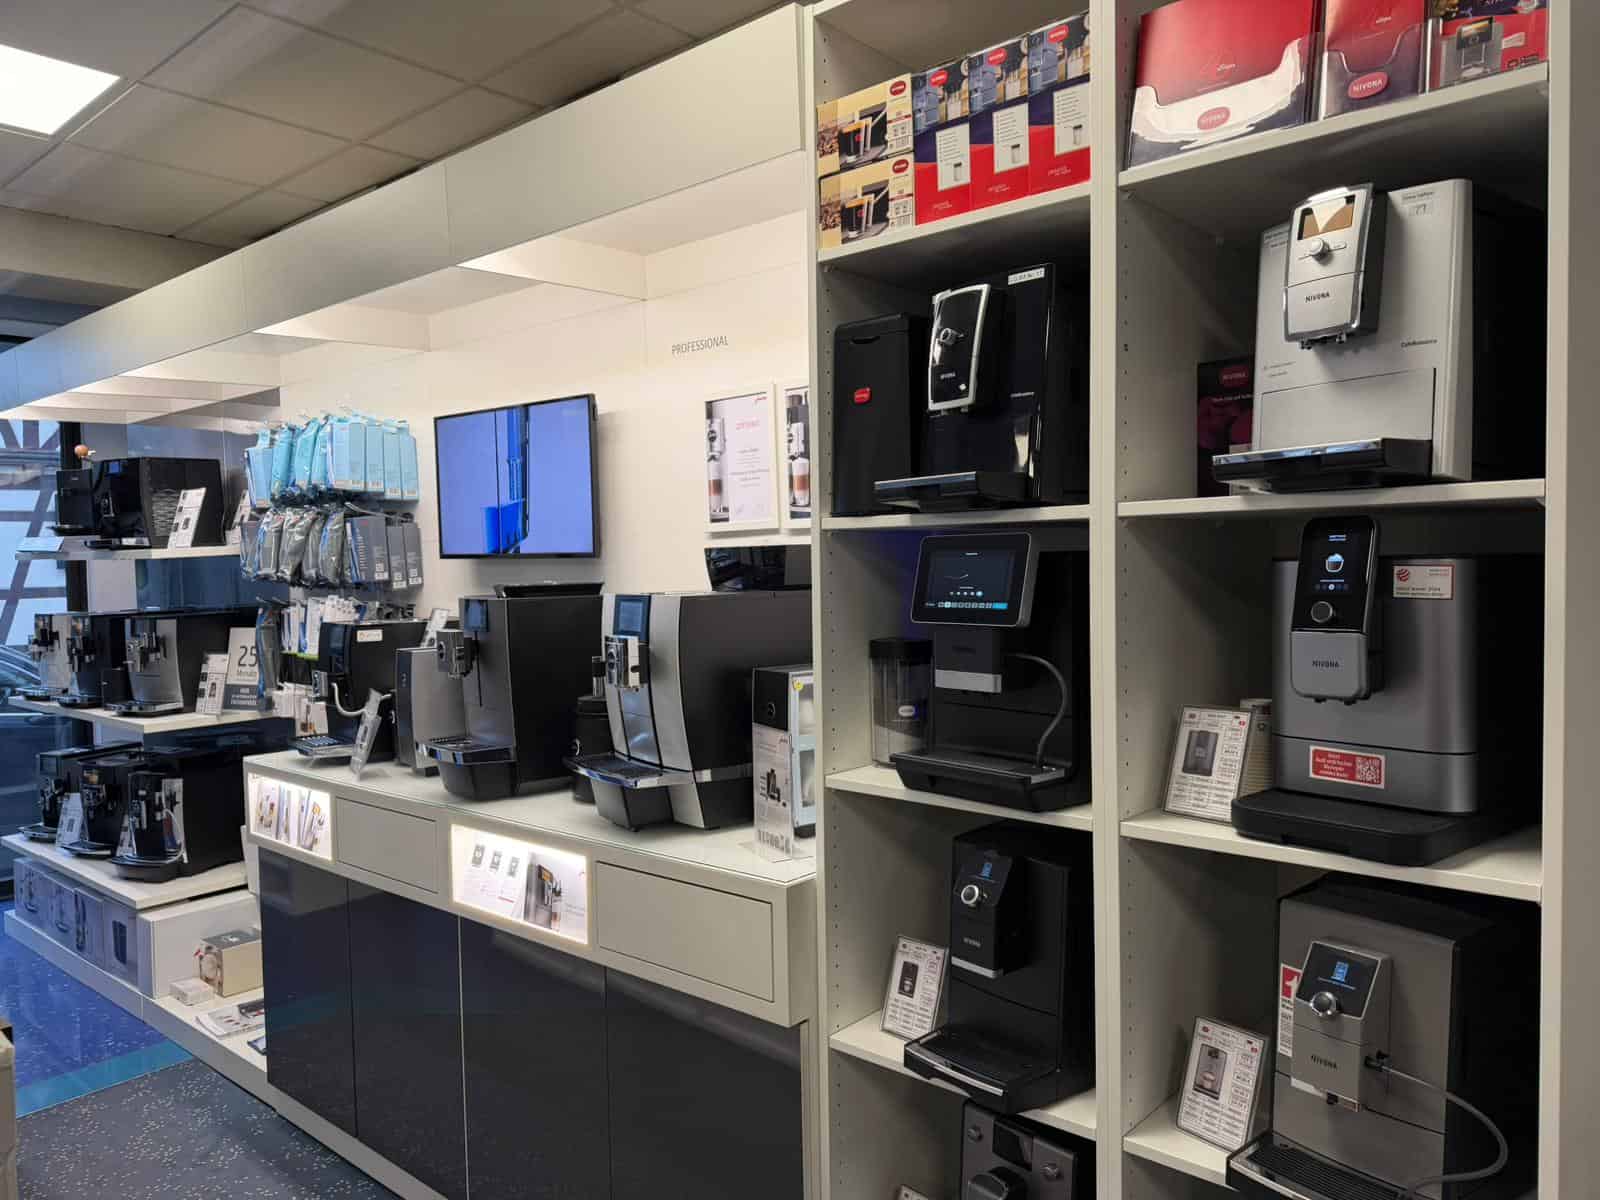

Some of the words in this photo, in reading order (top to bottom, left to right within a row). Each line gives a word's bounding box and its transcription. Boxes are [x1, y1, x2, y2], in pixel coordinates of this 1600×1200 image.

[1352, 79, 1384, 91] NIVONA
[1304, 291, 1330, 303] NIVONA
[671, 335, 728, 355] PROFESSIONAL
[238, 645, 258, 668] 25
[1312, 660, 1340, 668] NIVONA
